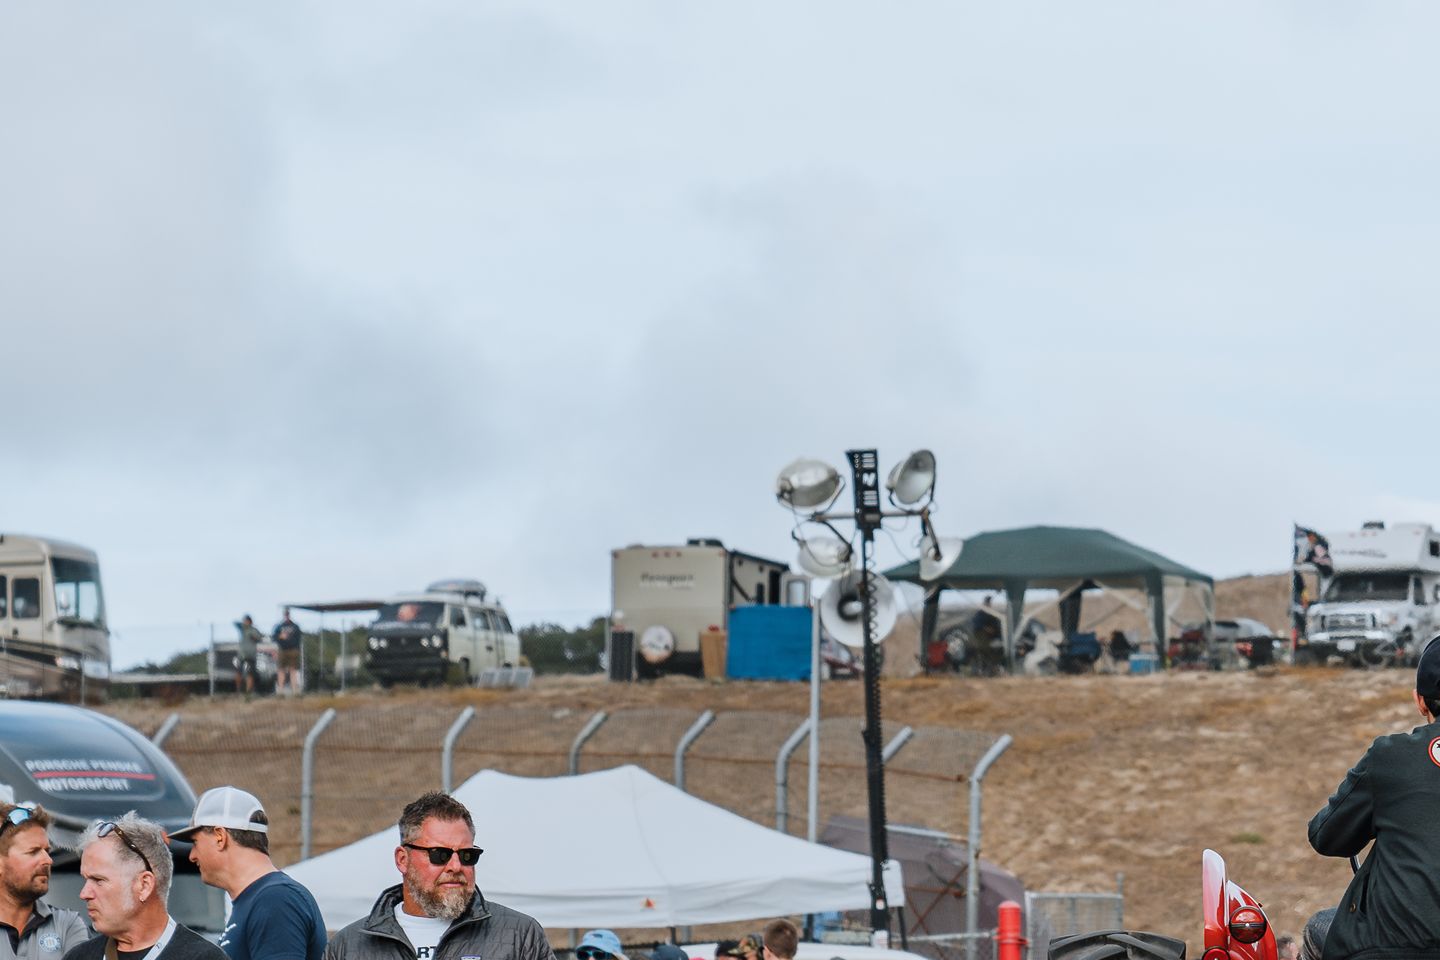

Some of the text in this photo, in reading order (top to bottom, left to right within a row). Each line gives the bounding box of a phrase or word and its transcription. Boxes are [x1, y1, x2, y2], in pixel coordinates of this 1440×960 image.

[25, 760, 142, 773] PORSCHE PENSKE
[38, 778, 131, 792] MOTORSPORT
